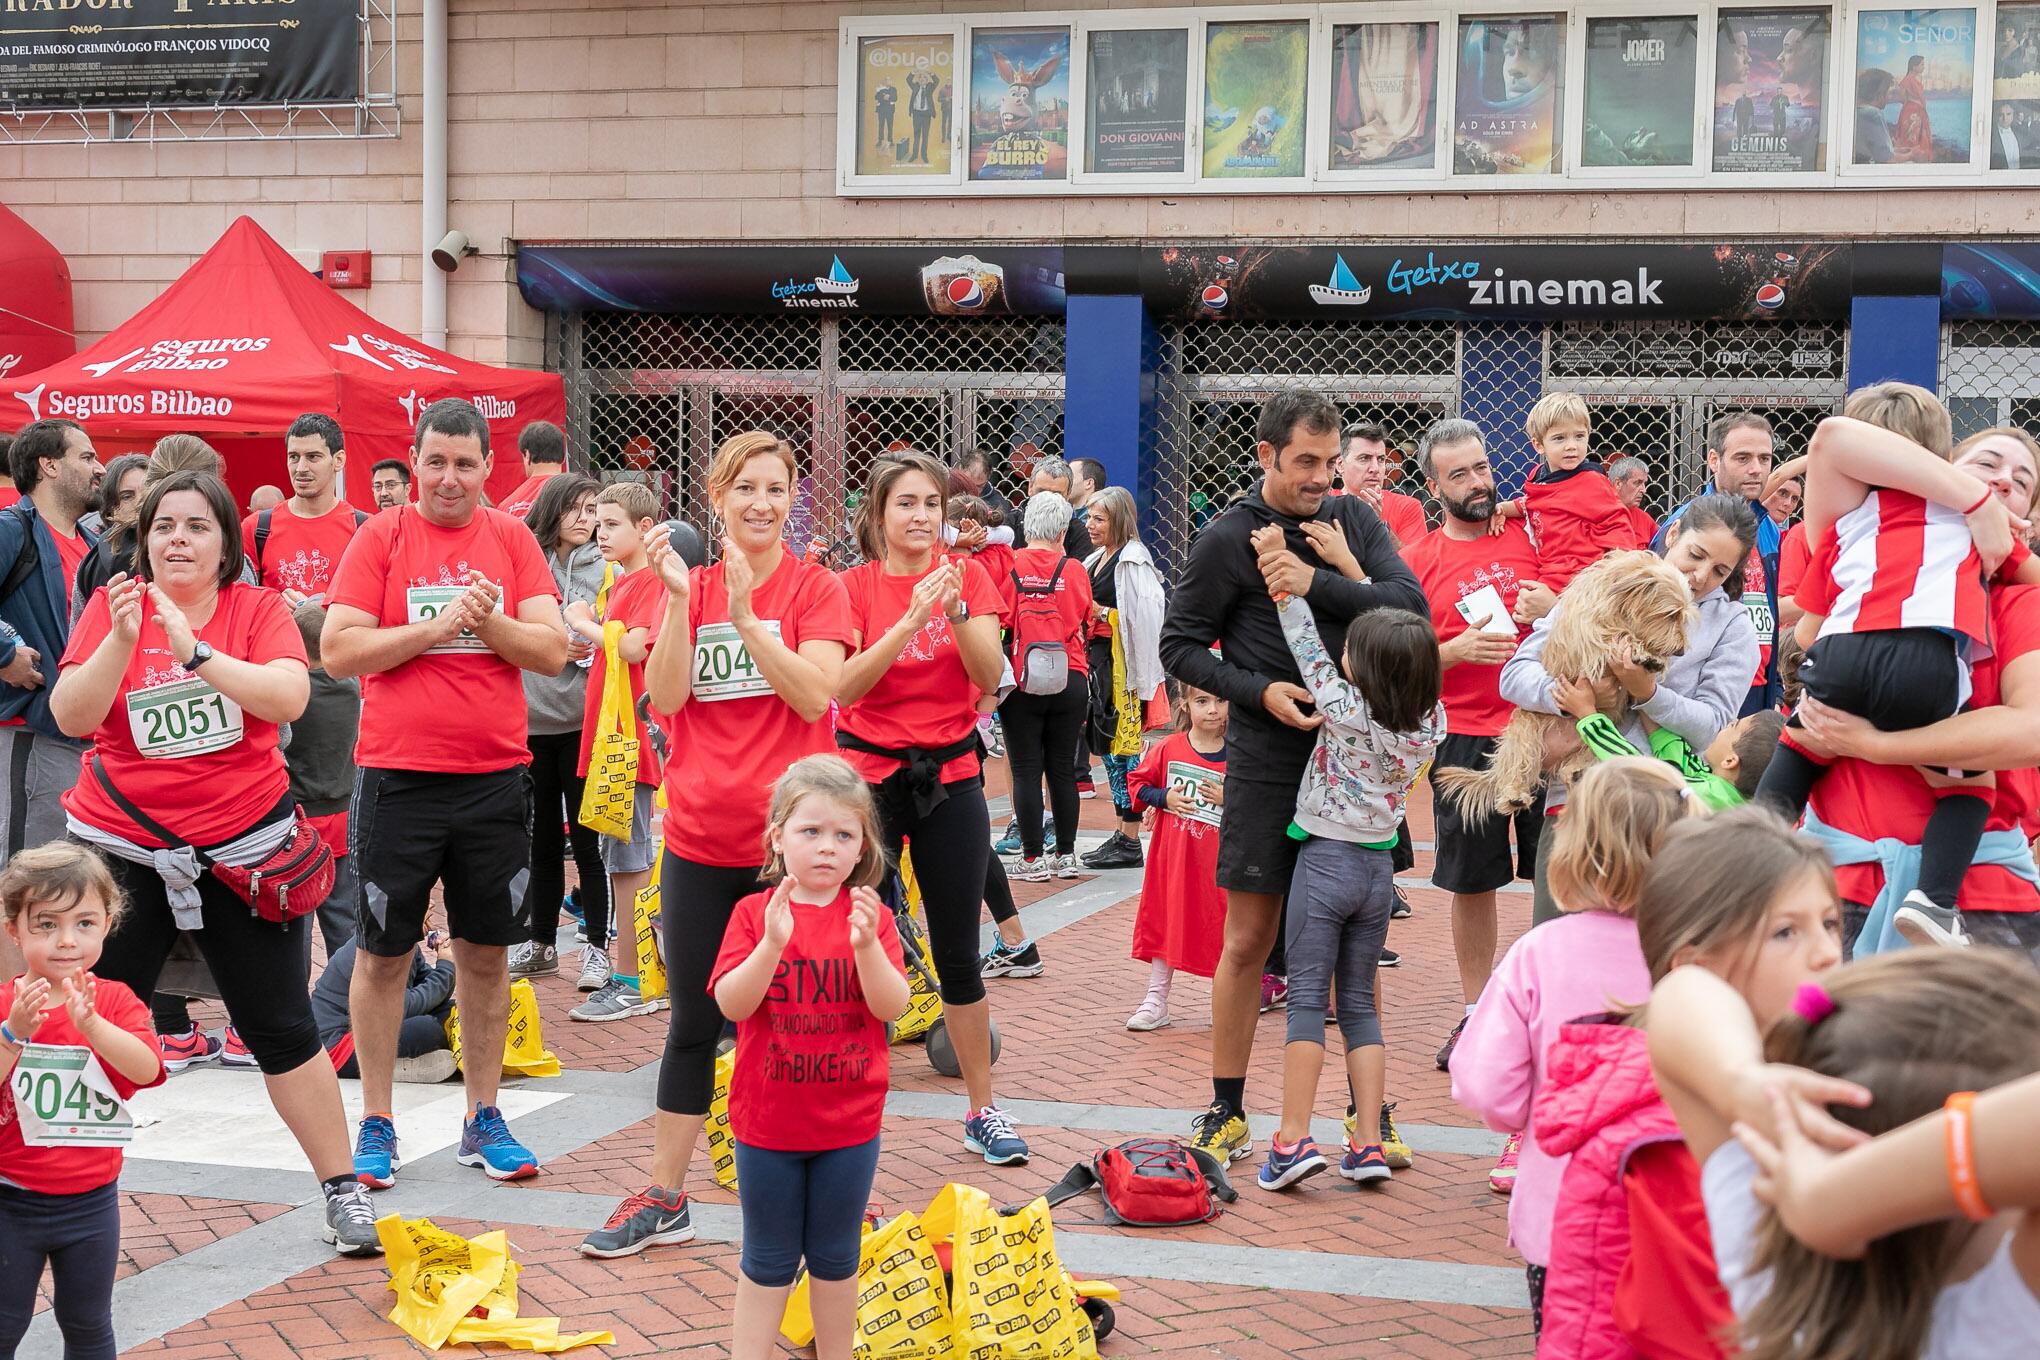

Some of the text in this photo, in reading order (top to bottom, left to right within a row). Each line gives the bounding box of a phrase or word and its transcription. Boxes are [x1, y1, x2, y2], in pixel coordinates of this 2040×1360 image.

[1898, 23, 1972, 43] SEÑOR
[12, 46, 31, 55] DEL
[33, 45, 75, 55] FAMOSO
[77, 41, 151, 53] CRIMINÓLOGO
[154, 39, 216, 53] FRANÇOIS
[219, 38, 270, 52] VIDOCQ
[1622, 39, 1665, 61] JOKER
[869, 47, 953, 69] @buelo
[1460, 121, 1538, 130] AD ASTRA
[996, 140, 1038, 151] EL REY
[1100, 132, 1184, 144] DON GIOVANNI
[1731, 134, 1788, 152] GÉMINIS
[987, 151, 1049, 165] BURRO
[1387, 252, 1480, 295] Getxo
[772, 279, 815, 298] Getxo
[1468, 267, 1663, 305] zinemak
[783, 295, 859, 308] zinemak
[144, 338, 271, 358] Seguros
[122, 356, 230, 373] Bilbao
[49, 390, 233, 419] Seguros Bilbao
[473, 395, 516, 418] Bilbao
[698, 644, 755, 681] 204
[143, 694, 228, 744] 2051
